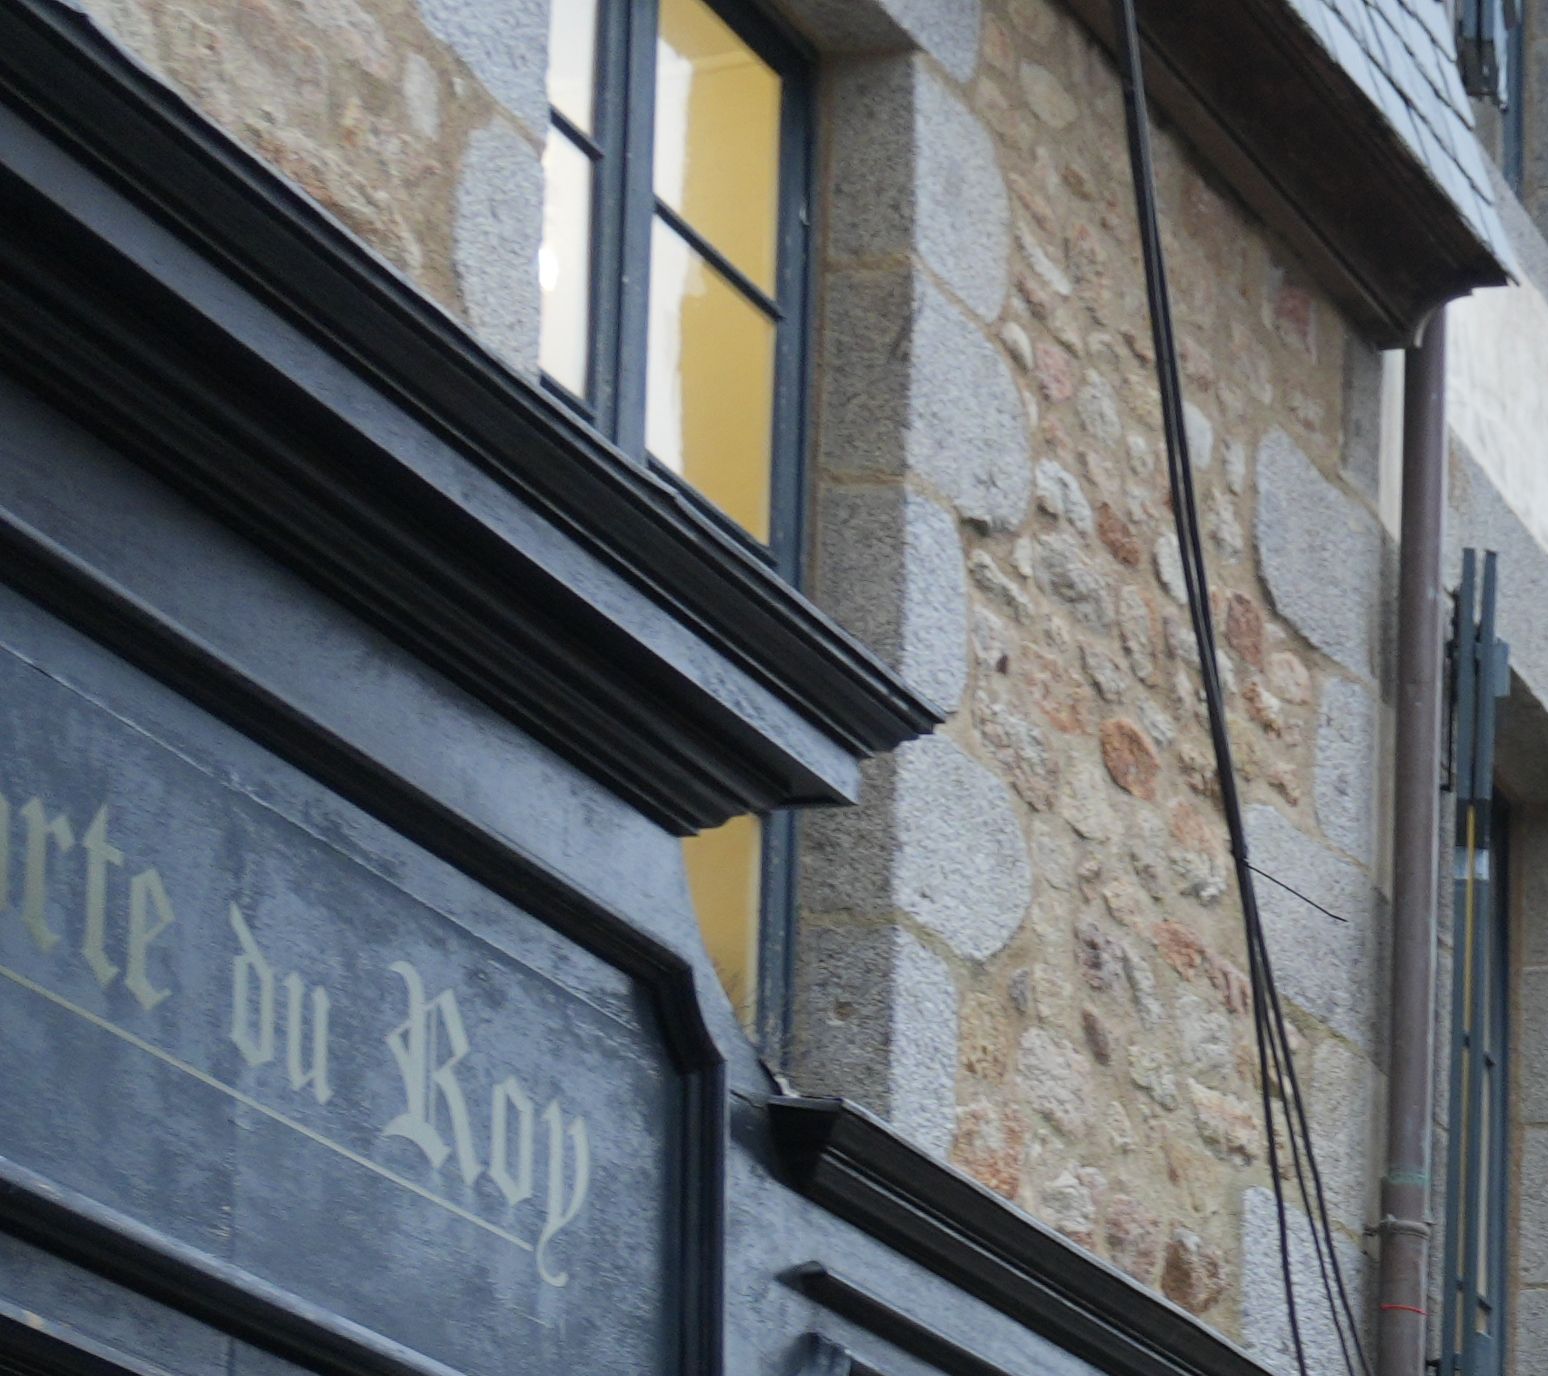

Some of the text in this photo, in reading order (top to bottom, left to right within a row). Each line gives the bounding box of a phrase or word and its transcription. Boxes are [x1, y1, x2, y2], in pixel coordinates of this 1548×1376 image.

[0, 791, 590, 1287] rte du Roy
